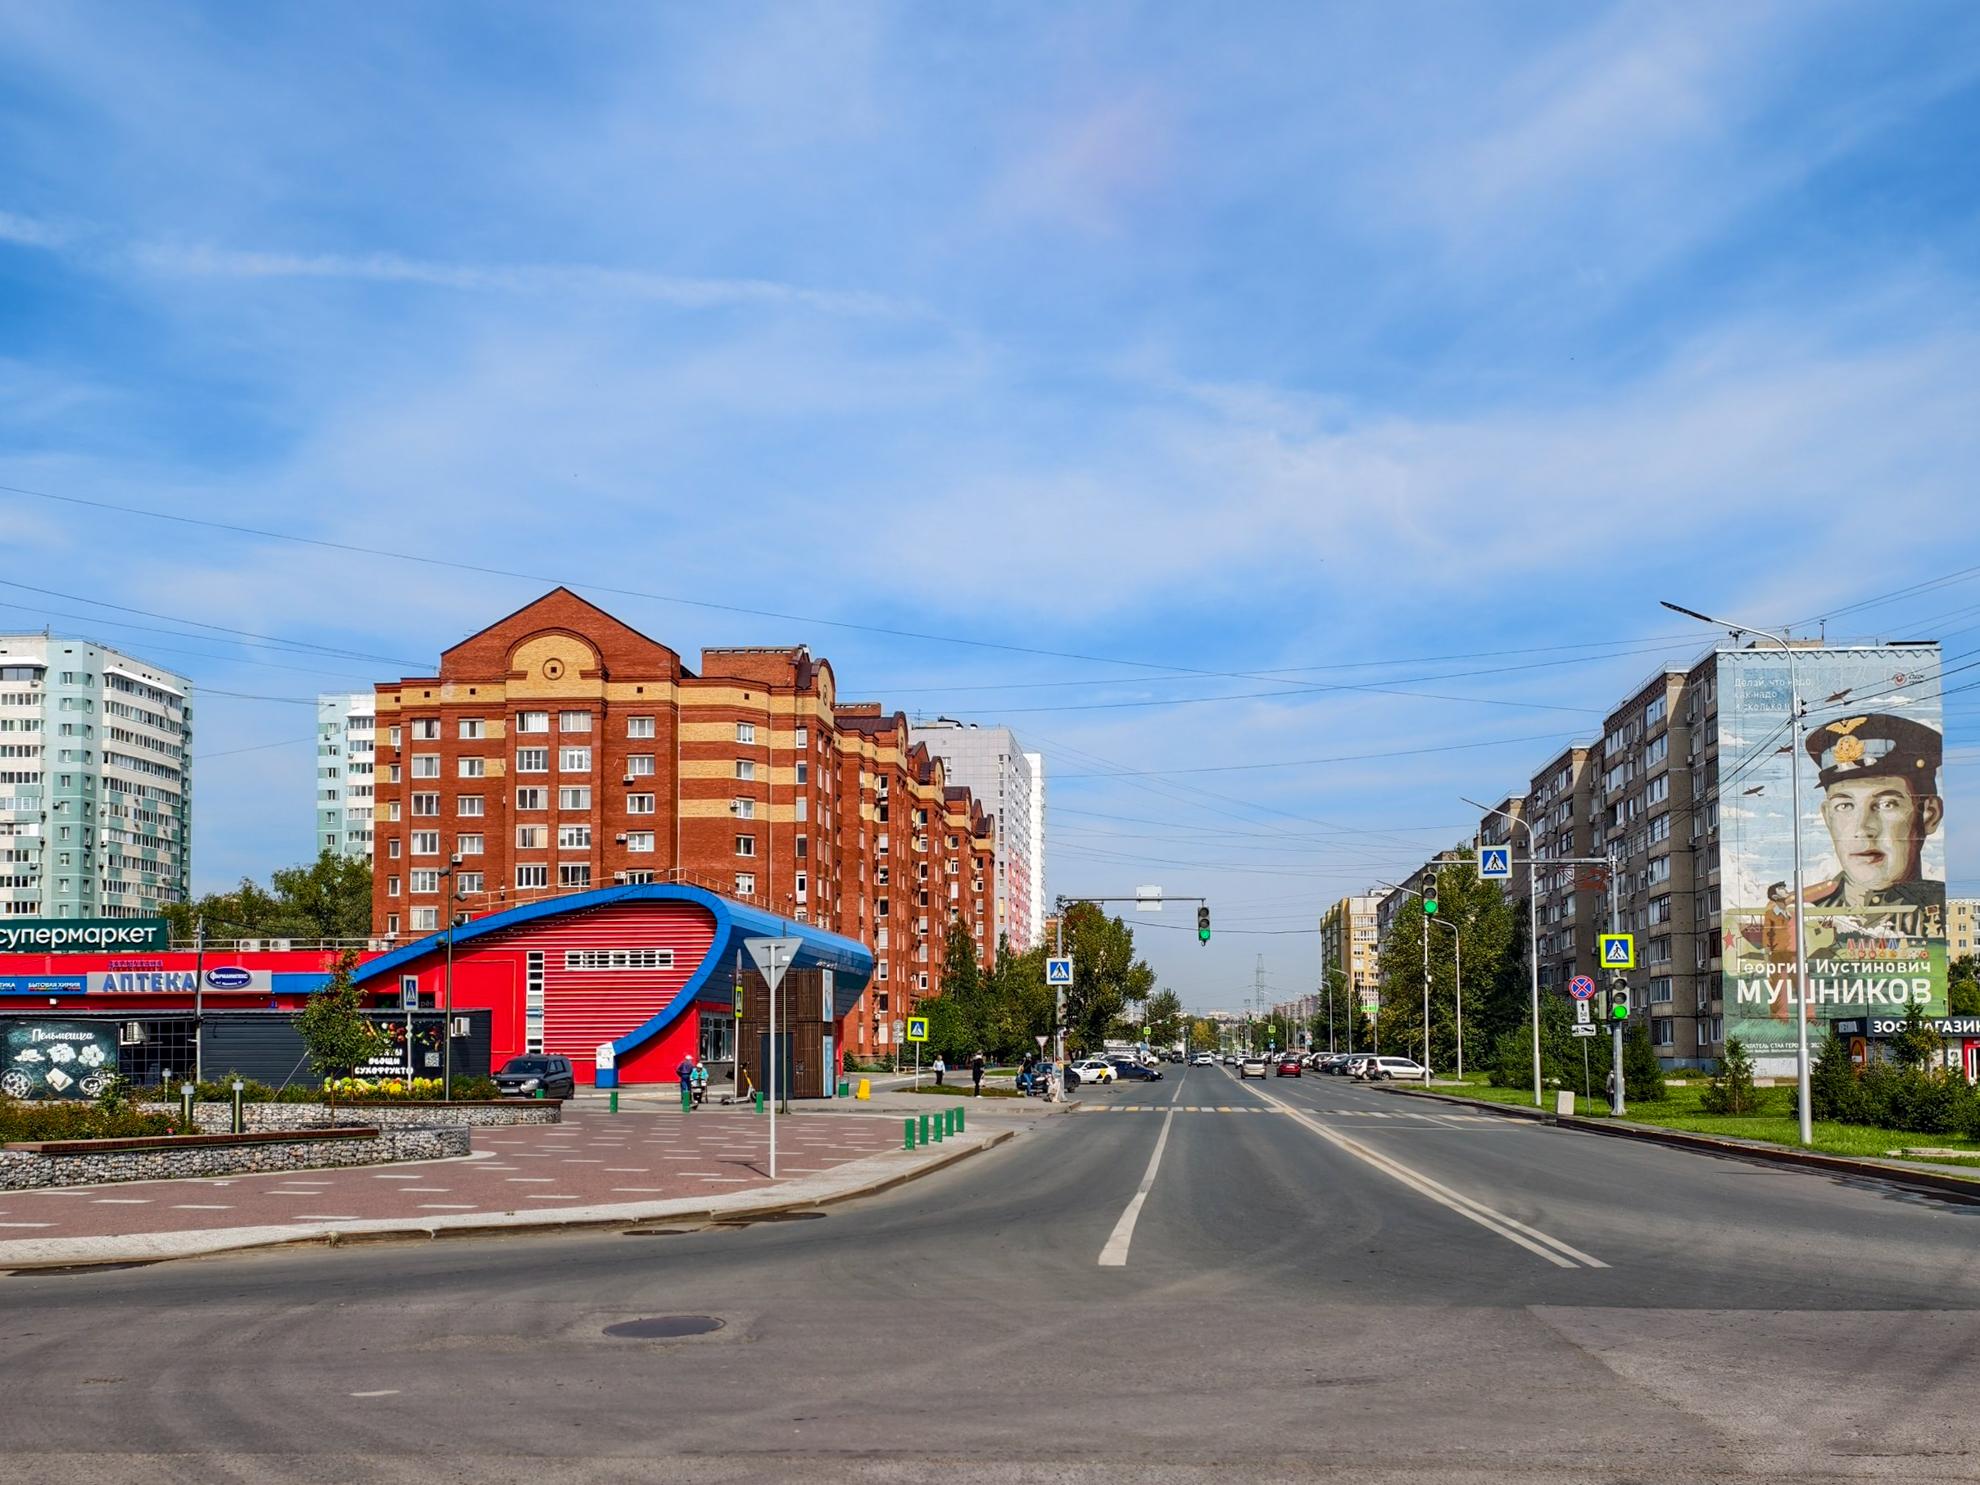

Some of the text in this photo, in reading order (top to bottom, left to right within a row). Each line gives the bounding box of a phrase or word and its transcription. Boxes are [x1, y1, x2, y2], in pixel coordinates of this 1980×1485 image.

[0, 927, 157, 949] супермаркет
[1816, 959, 1931, 976] Иустинович
[102, 970, 198, 992] АПТЕКА
[1737, 978, 1932, 1004] МУШНИКОВ
[32, 1028, 96, 1042] Пельмешка
